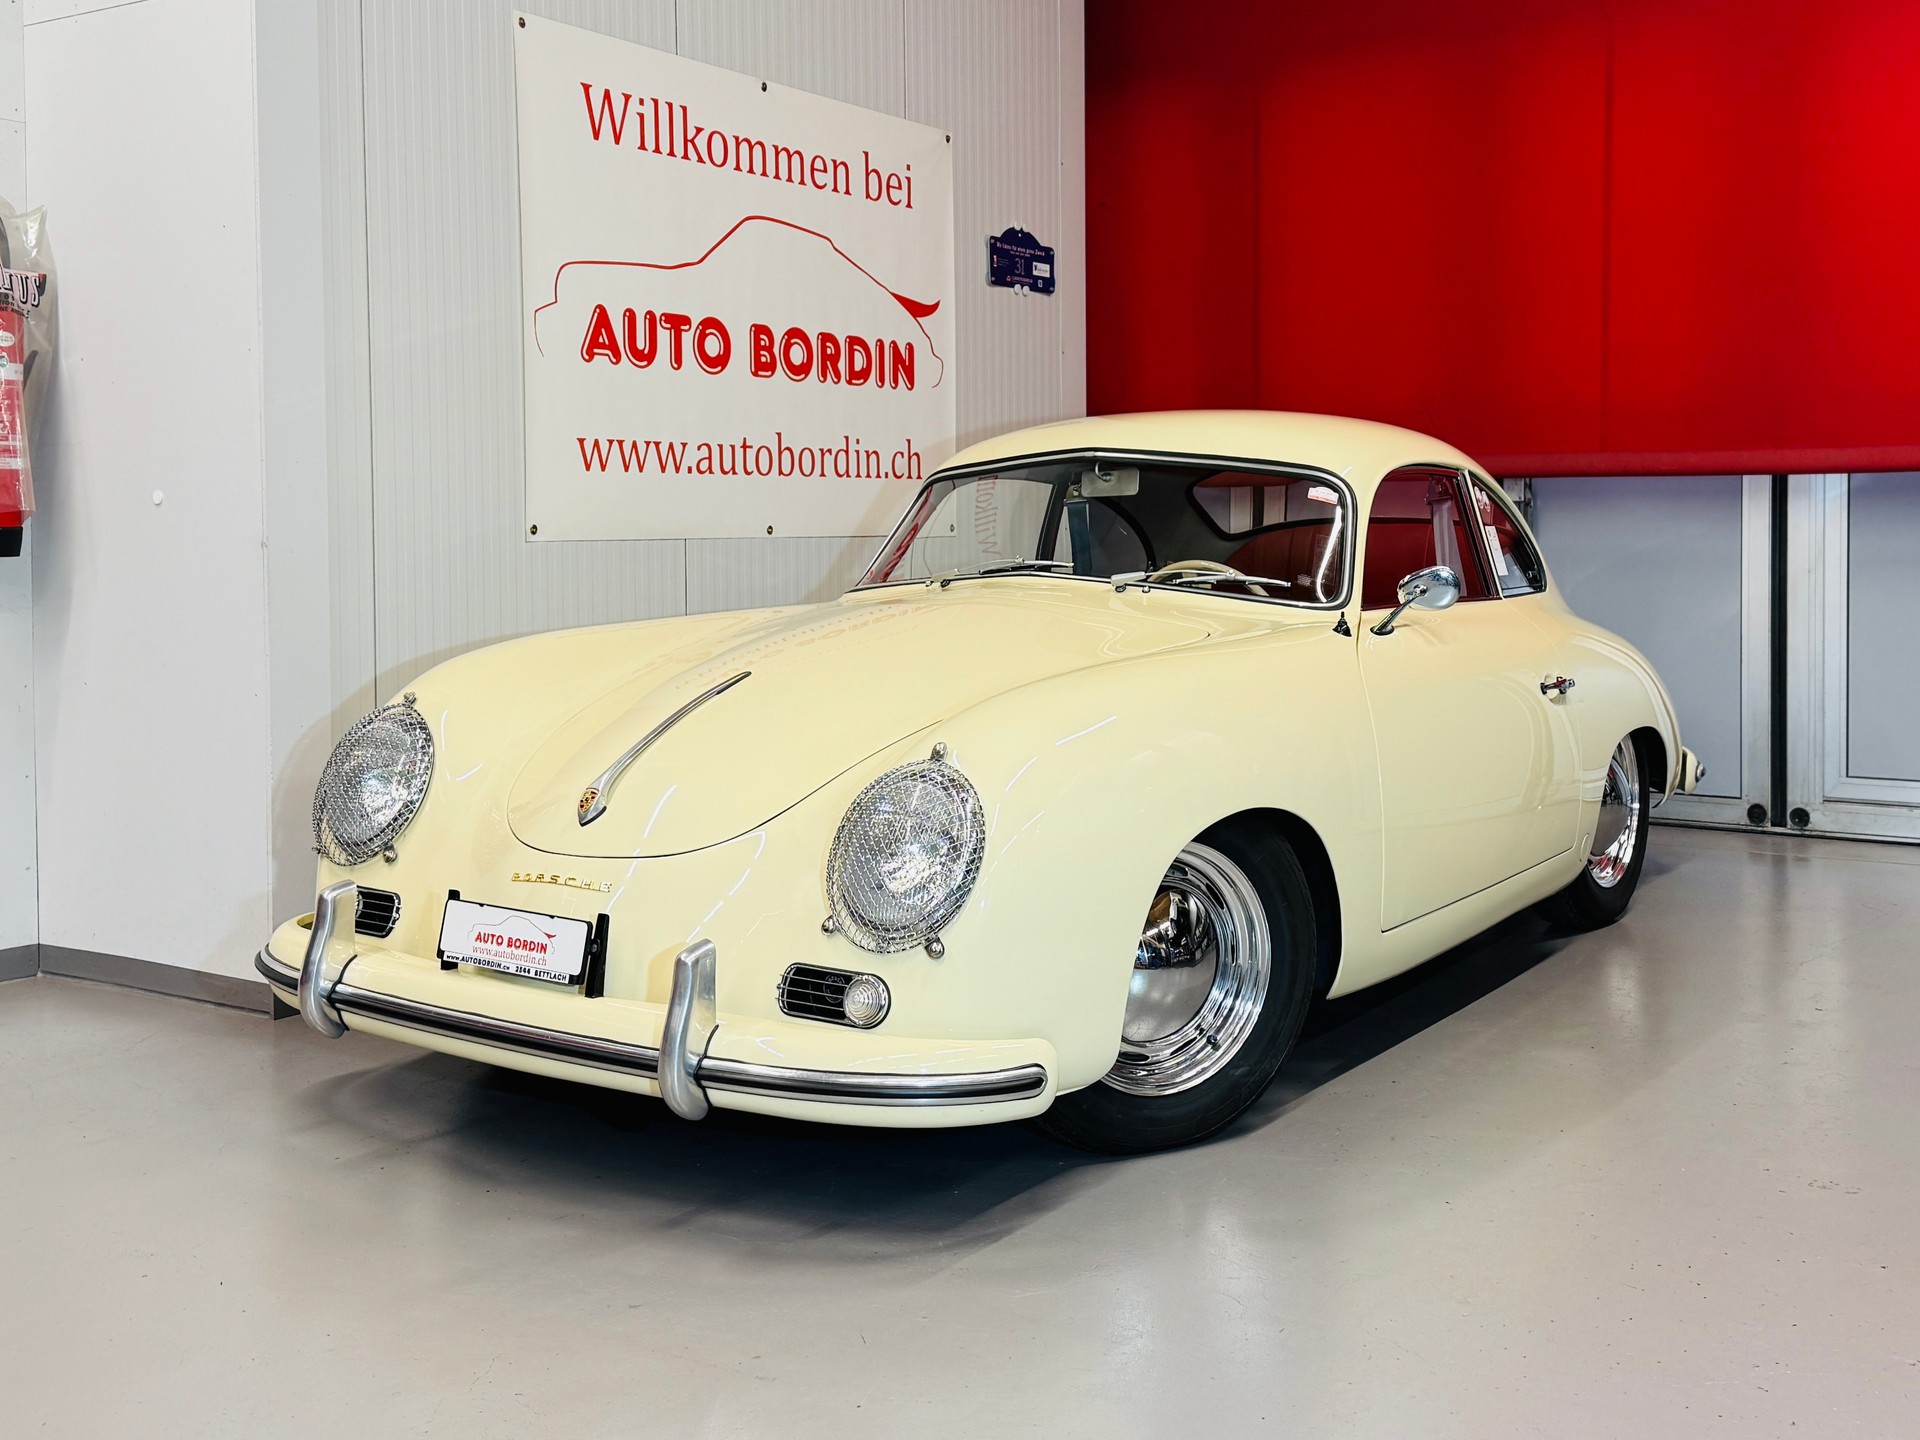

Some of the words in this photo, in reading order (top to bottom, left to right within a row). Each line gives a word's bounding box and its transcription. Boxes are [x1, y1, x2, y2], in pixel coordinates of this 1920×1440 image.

[580, 82, 852, 196] Willkommen
[863, 150, 914, 209] bei
[1014, 257, 1025, 275] 31
[580, 303, 733, 376] AUTO
[749, 322, 916, 392] BORDIN
[576, 431, 923, 480] www.autobordin.ch
[511, 872, 613, 893] PORSCHE
[474, 931, 504, 947] AUTO
[506, 936, 548, 955] BORDIN
[472, 945, 547, 967] www.autobordin.ch
[515, 965, 531, 975] 2544
[534, 969, 567, 982] BETTLACH
